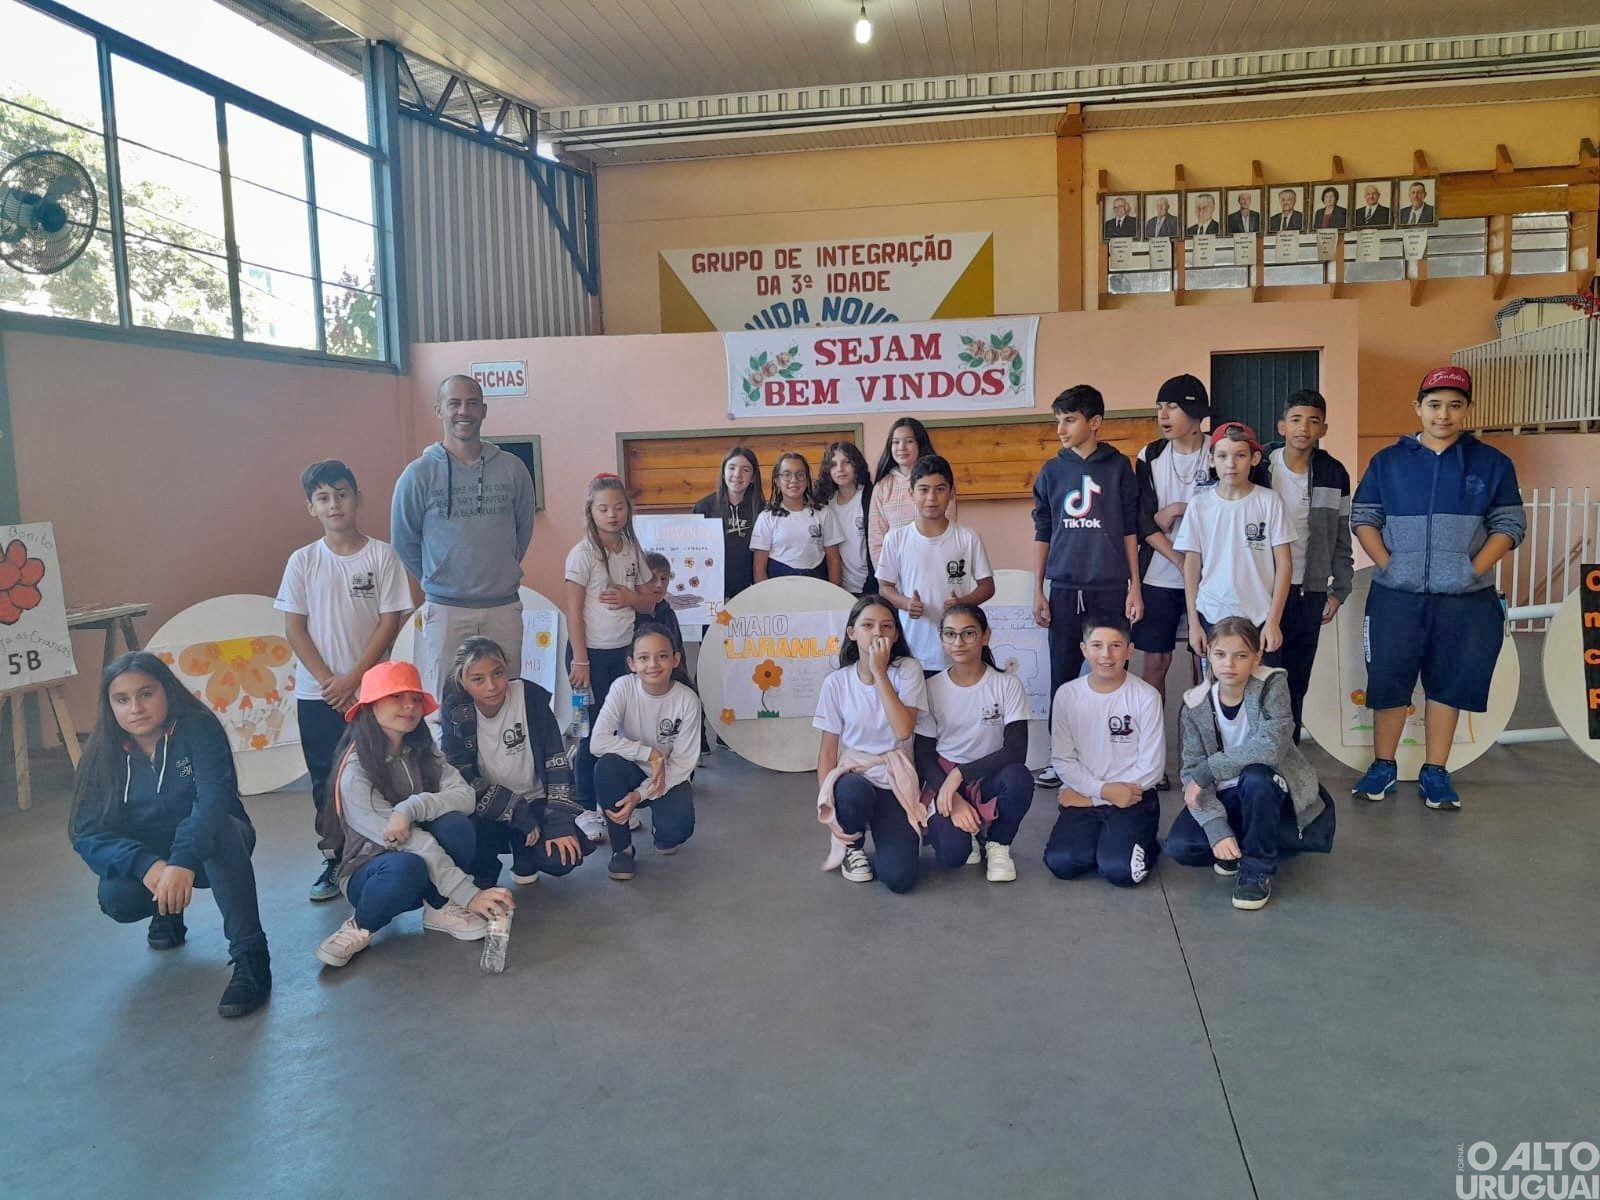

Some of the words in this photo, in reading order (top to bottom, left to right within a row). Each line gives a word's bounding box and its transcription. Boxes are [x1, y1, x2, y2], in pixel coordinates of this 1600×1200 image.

[692, 249, 763, 273] GRUPO
[774, 247, 802, 270] DE
[816, 234, 952, 268] INTEGRAÇÃO
[756, 274, 782, 297] DA
[827, 270, 891, 294] IDADE
[813, 333, 942, 366] SEJAM
[474, 369, 525, 388] FICHAS
[764, 378, 840, 407] BEM
[855, 368, 1006, 402] VINDOS
[1063, 518, 1102, 529] TikTok
[8, 525, 53, 550] Bonito
[727, 614, 789, 638] MAIO
